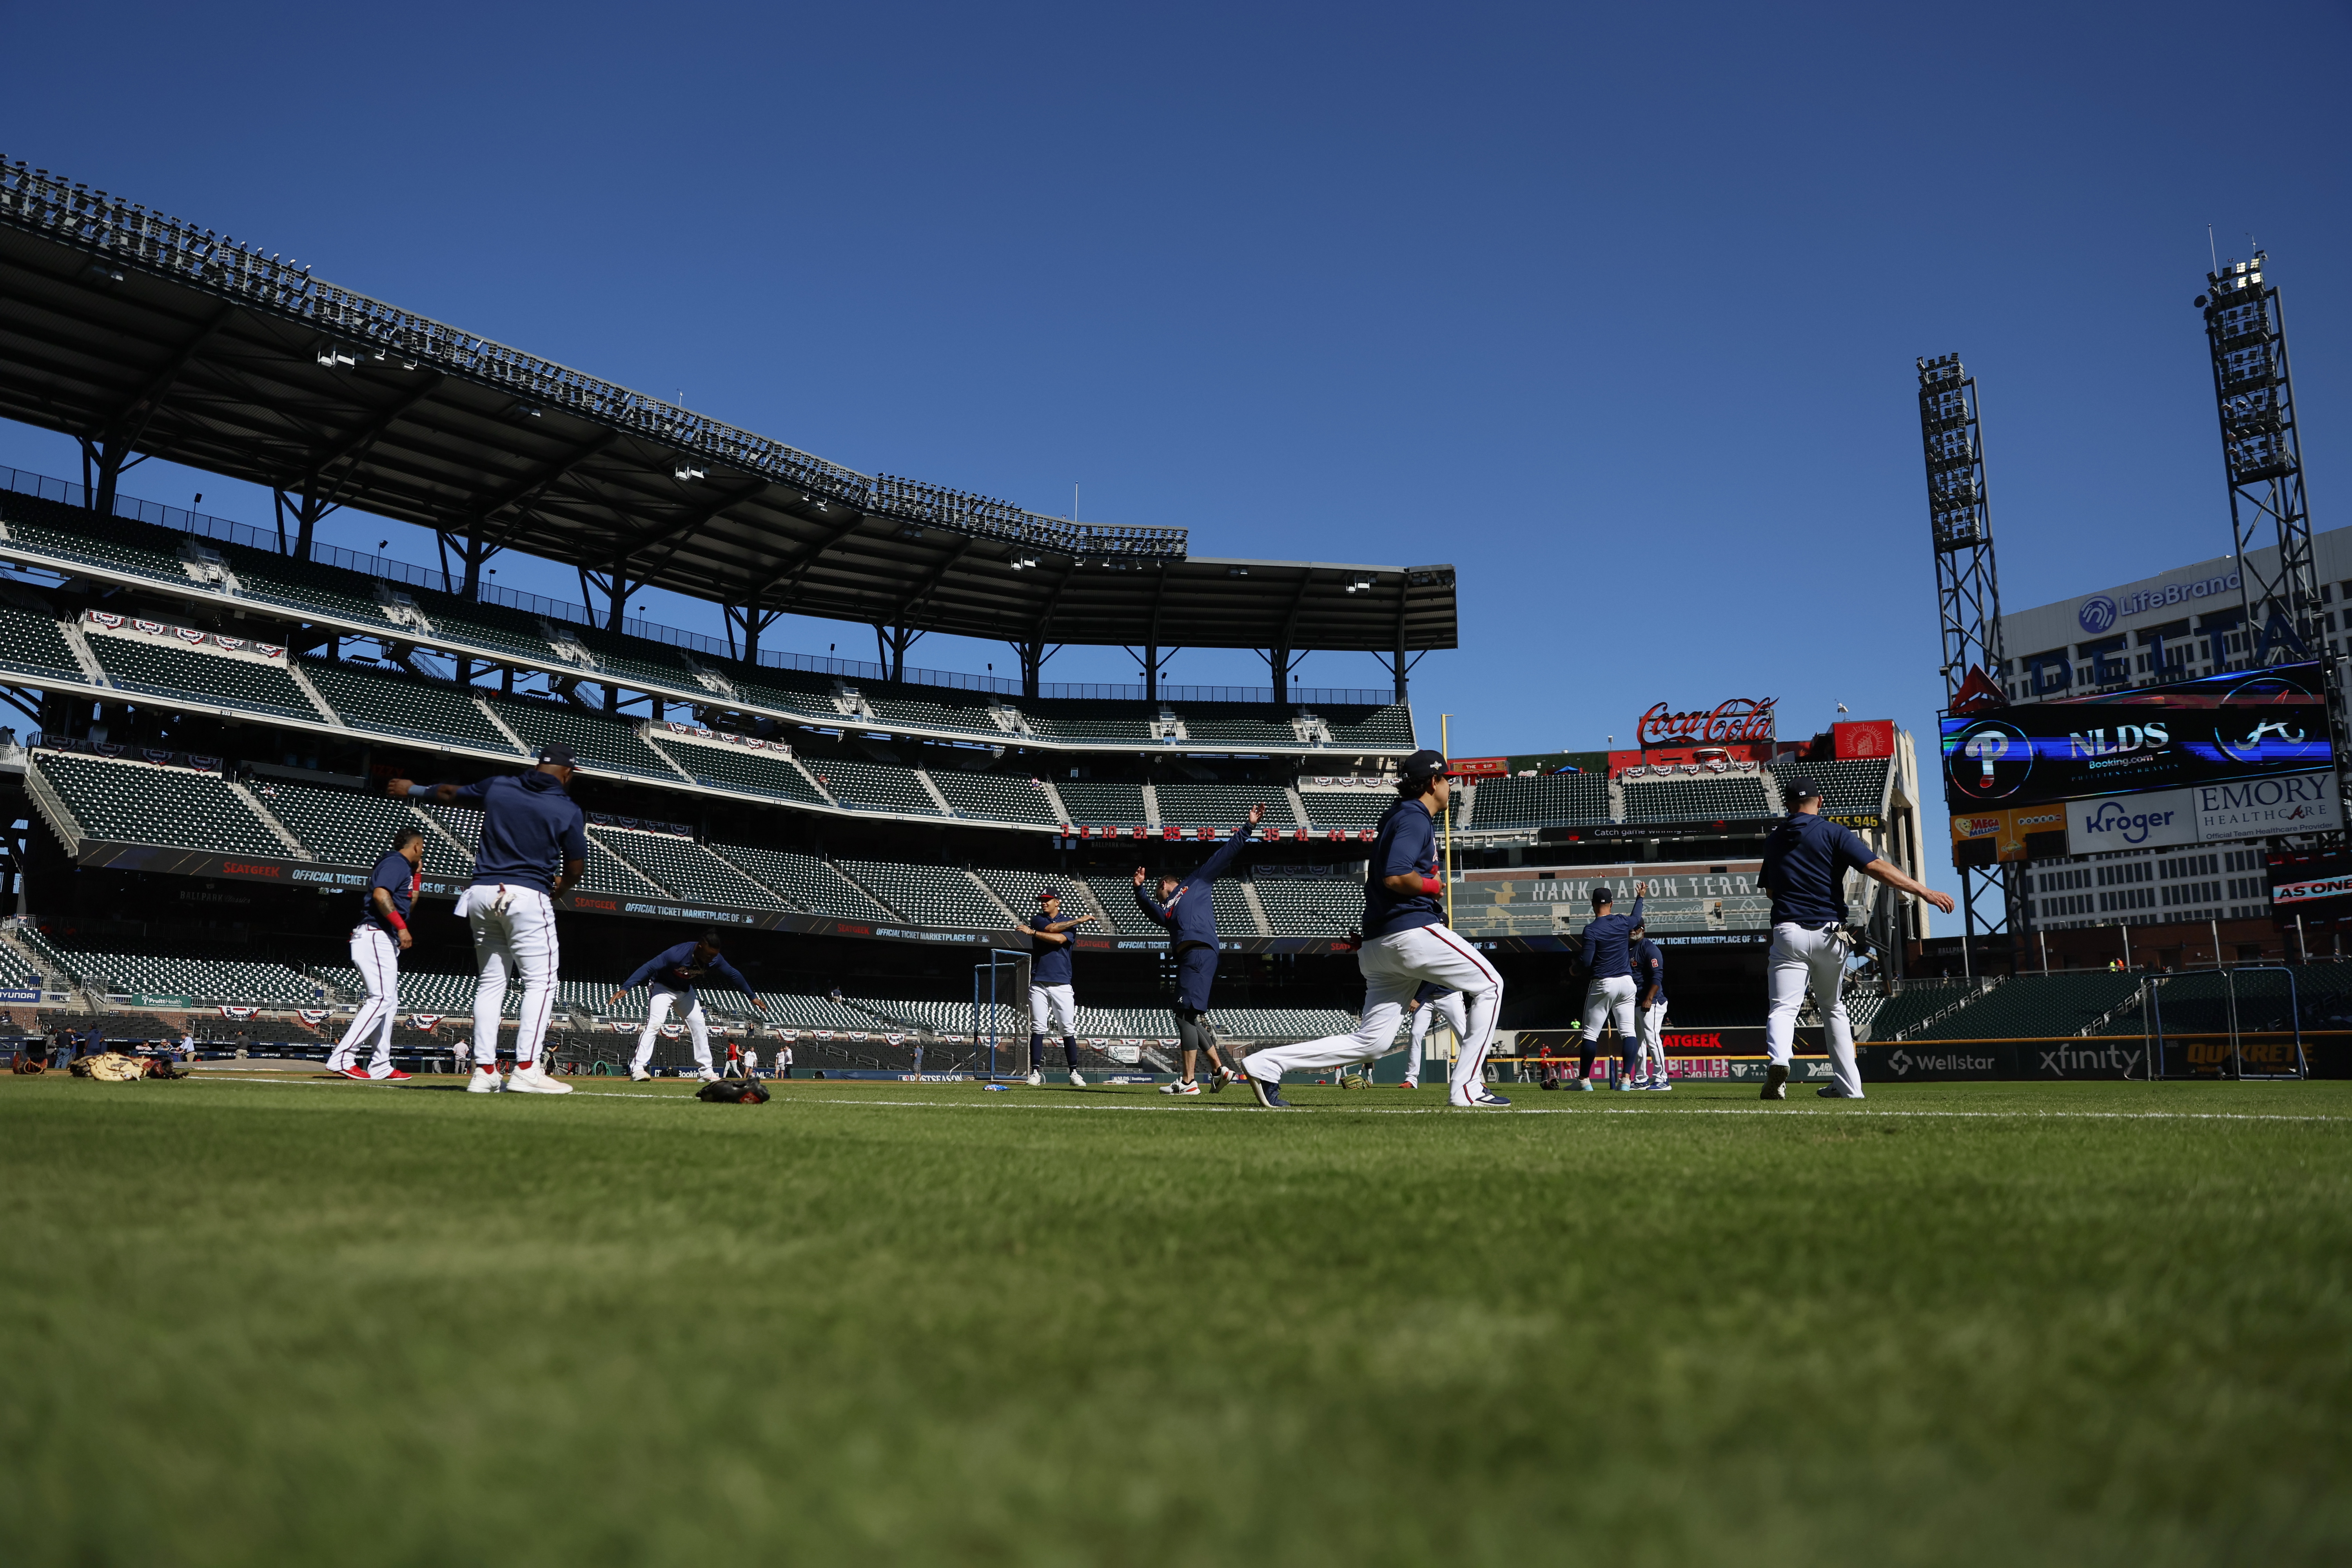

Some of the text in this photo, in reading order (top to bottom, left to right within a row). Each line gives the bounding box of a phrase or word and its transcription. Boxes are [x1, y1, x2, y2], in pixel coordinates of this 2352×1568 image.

[2120, 567, 2241, 617] LifeBrand
[2031, 613, 2315, 696] DELTA
[2069, 722, 2169, 759] NLDS
[2089, 755, 2154, 769] Booking.com
[2200, 775, 2329, 811] EMORY
[2019, 816, 2053, 824] POWER
[2204, 805, 2327, 826] HEALTHCARE
[1971, 818, 1999, 830] MEGA
[2086, 802, 2174, 843] Kroger
[1061, 824, 1069, 838] 3
[1081, 826, 1089, 838] 6
[1102, 826, 1117, 838] 10
[1133, 826, 1148, 839] 21
[1164, 827, 1181, 839] 25
[1198, 828, 1215, 840] 29
[1263, 828, 1280, 840] 35
[1294, 829, 1309, 841] 41
[1328, 829, 1346, 842] 44
[1359, 829, 1375, 842] 47
[1969, 826, 2000, 837] MILLIONS
[2256, 826, 2298, 835] Healthcare
[223, 862, 281, 878] SEATGEEK
[292, 869, 334, 883] OFFICIAL
[336, 874, 368, 886] TICKET
[434, 884, 445, 893] OF
[1533, 881, 1589, 901] HANK
[2279, 886, 2306, 899] AS
[180, 891, 223, 902] BALLPARK
[575, 897, 740, 922] SEATGEEK OFFICIAL TICKET MARKETPLACE OF
[837, 924, 870, 935] SEATGEEK
[876, 928, 900, 937] OFFICIAL
[901, 930, 920, 940] TICKET
[920, 932, 966, 942] MARKETPLACE
[1076, 940, 1110, 949] SEATGEEK
[1691, 936, 1742, 945] MARKETPLACE
[1651, 958, 1659, 968] 2
[1659, 1033, 1723, 1048] ATGEEK
[1113, 1047, 1135, 1058] Sugarlands
[1916, 1055, 1995, 1070] Wellstar
[2040, 1043, 2141, 1076] xfinity
